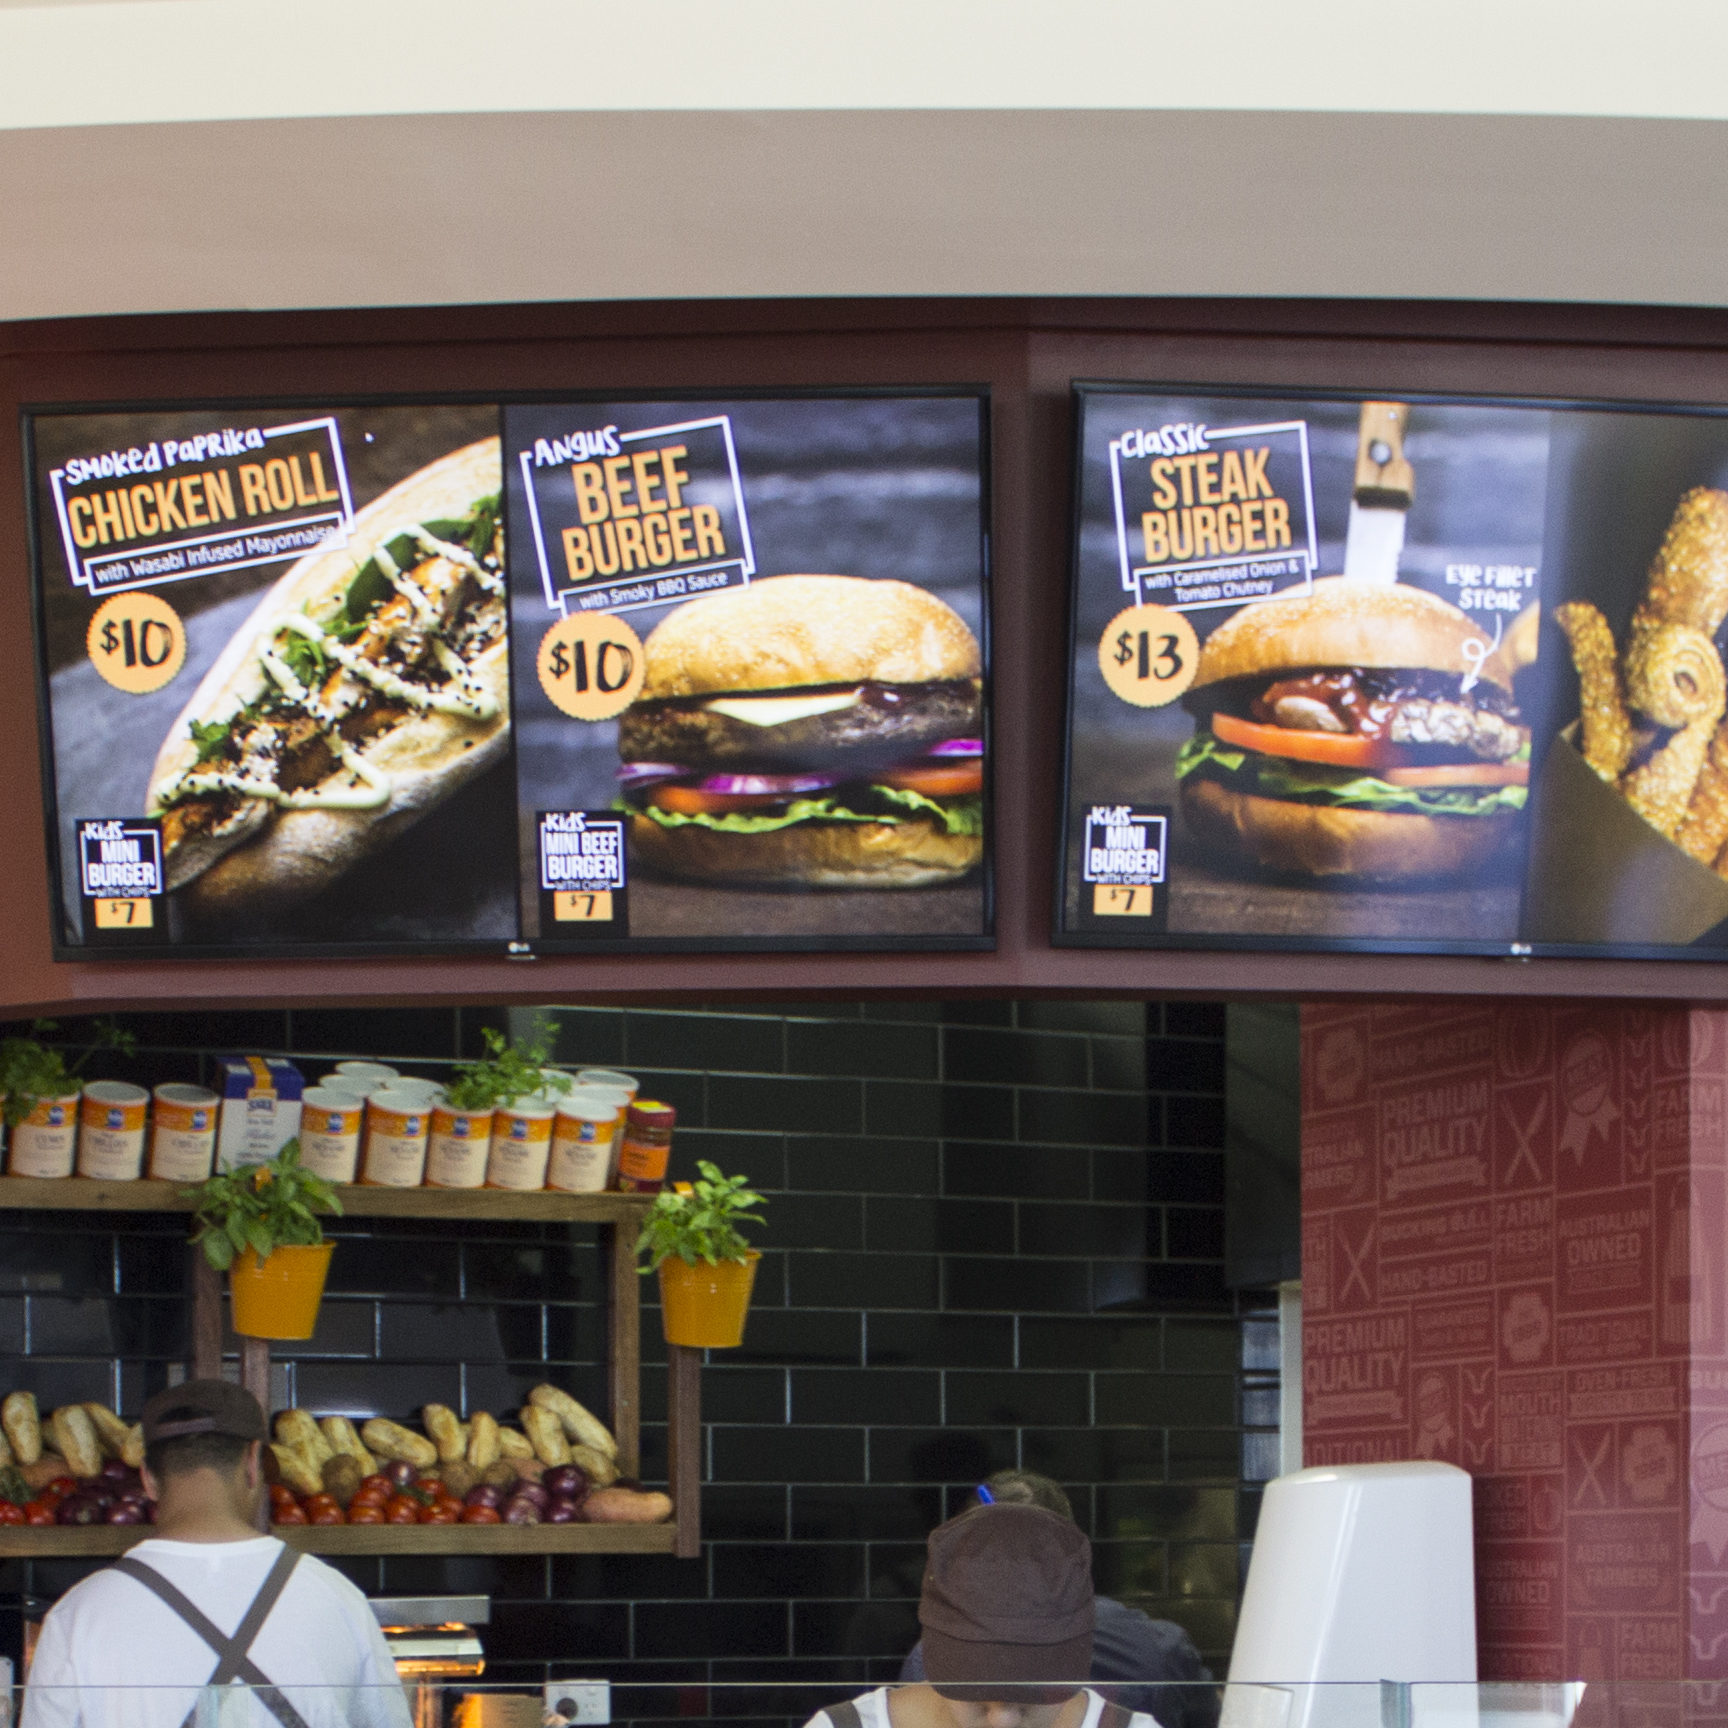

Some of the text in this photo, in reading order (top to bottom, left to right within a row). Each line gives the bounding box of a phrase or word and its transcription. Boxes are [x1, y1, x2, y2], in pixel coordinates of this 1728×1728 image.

[572, 445, 689, 524] BEEF
[1150, 446, 1274, 510] STEAK
[68, 451, 339, 549] CHICKEN ROLL
[561, 504, 726, 580] BURGER
[1141, 498, 1292, 562] BURGER
[95, 562, 130, 583] with
[132, 550, 186, 575] Wasabi
[187, 540, 245, 566] Infused
[1145, 574, 1172, 589] with
[1250, 561, 1285, 579] Onion
[611, 585, 655, 605] Smoky
[656, 577, 686, 595] BBQ
[687, 572, 729, 591] Sauce
[1174, 586, 1221, 602] Tomato
[100, 619, 173, 668] $10
[1113, 630, 1183, 680] $13
[549, 641, 633, 693] $10
[100, 840, 140, 863] MINI
[546, 831, 618, 854] MINI BEEF
[1105, 825, 1145, 850] MINI
[88, 862, 156, 887] BURGER
[548, 855, 618, 879] BURGER
[1090, 848, 1159, 873] BURGER
